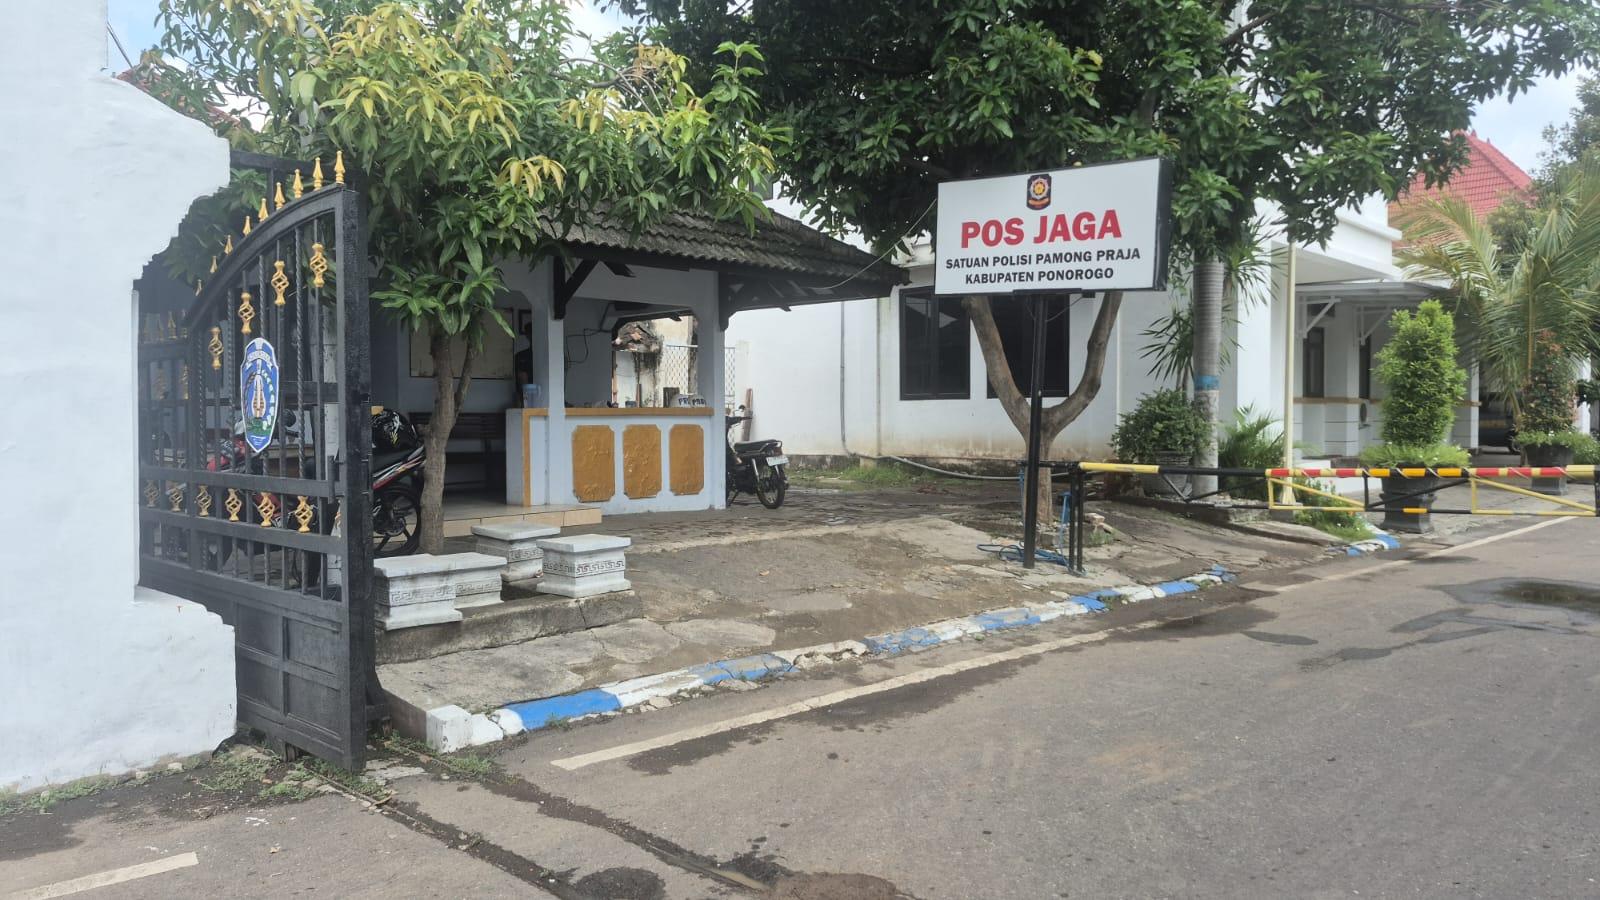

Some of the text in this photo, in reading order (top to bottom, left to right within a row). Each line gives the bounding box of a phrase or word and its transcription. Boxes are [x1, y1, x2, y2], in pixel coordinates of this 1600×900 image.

[961, 209, 1122, 248] POS JAGA
[946, 247, 1141, 269] SATUAN POLISI PAMONG PRAJA
[965, 267, 1114, 285] KABUPATEN PONOROGO
